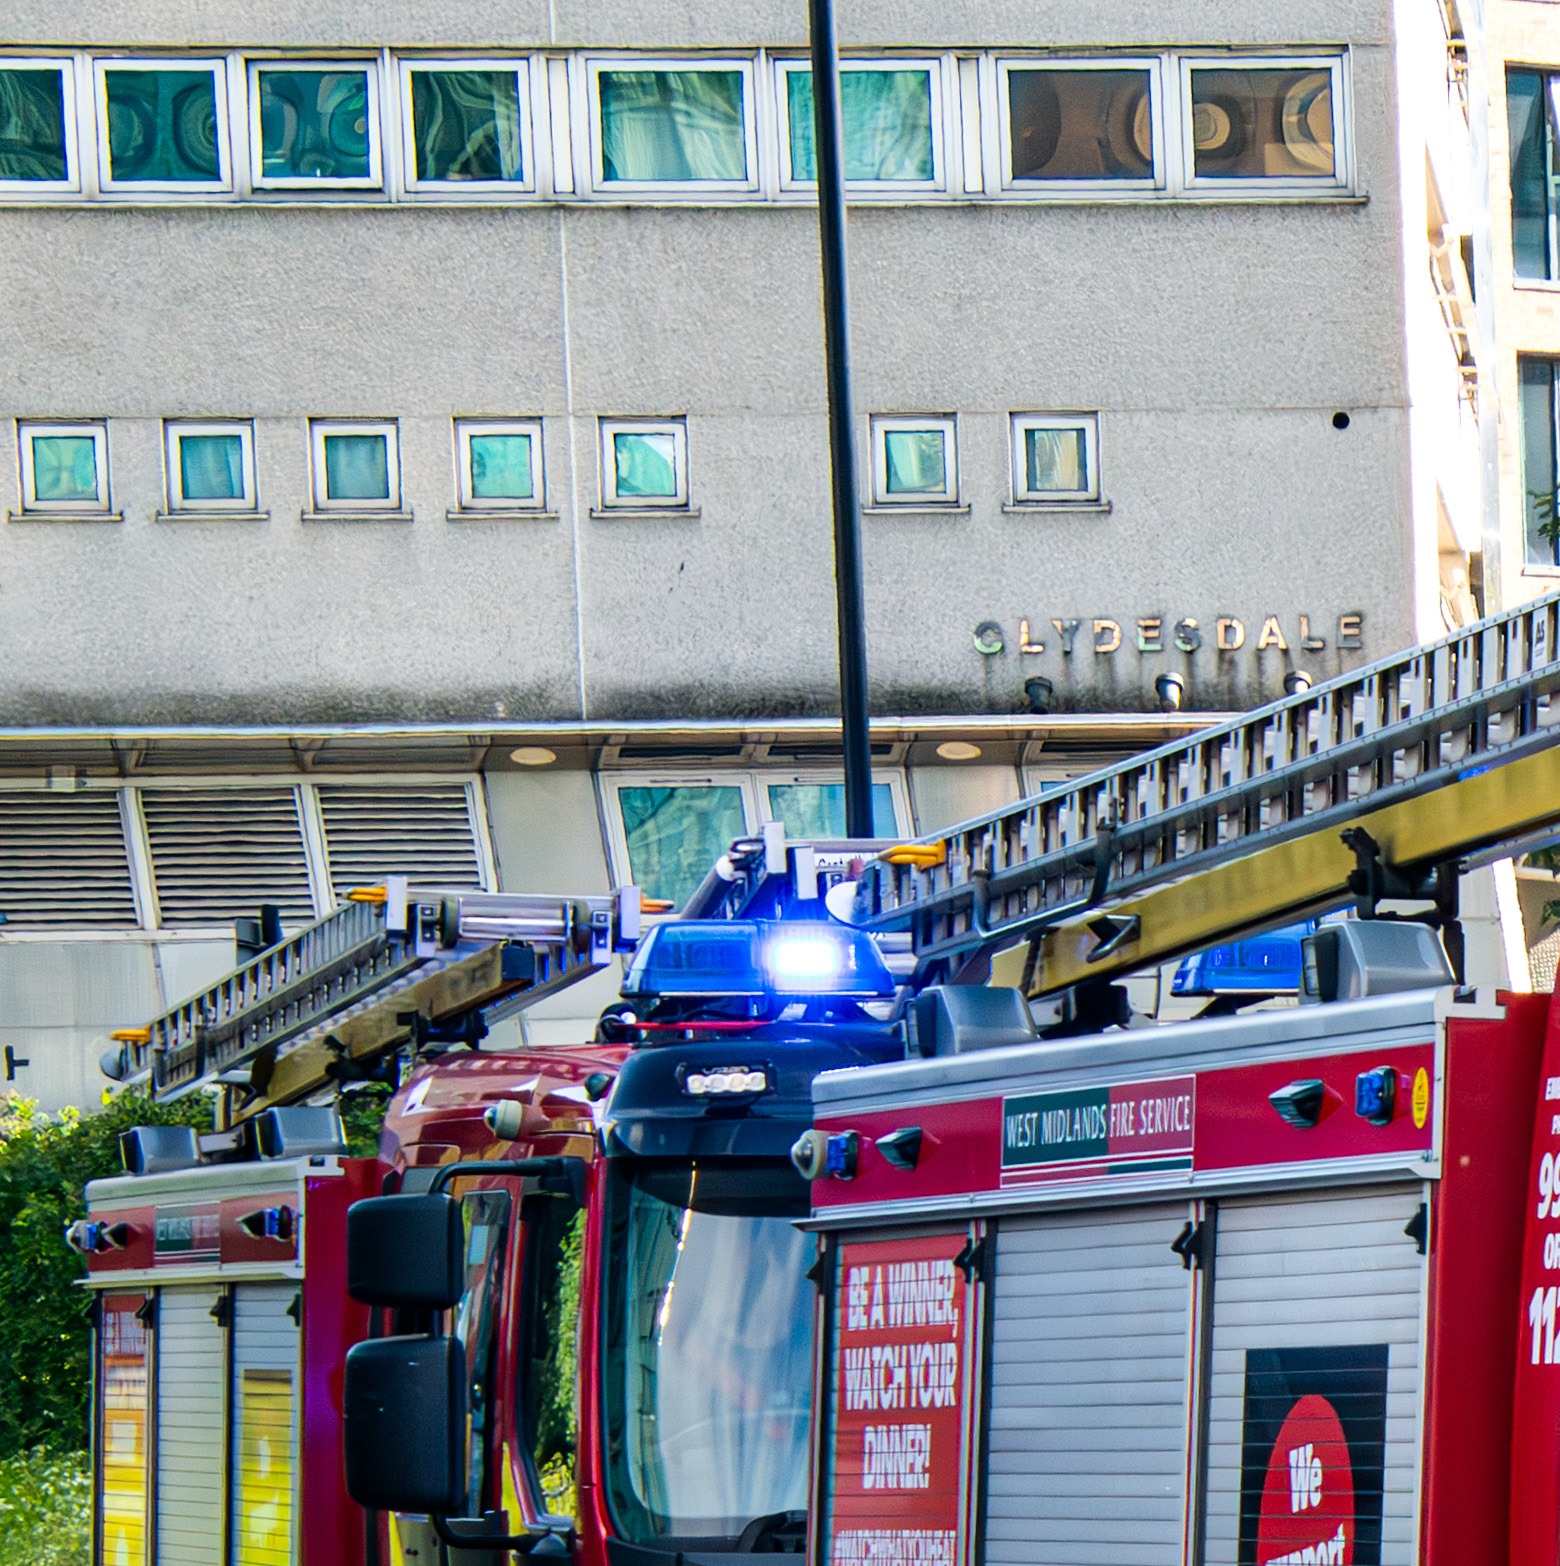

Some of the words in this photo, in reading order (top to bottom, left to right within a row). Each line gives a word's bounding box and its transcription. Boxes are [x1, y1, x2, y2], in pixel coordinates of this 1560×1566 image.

[973, 611, 1363, 654] CLYDESDALE
[1007, 1112, 1038, 1149] WEST
[1041, 1104, 1107, 1145] MIDLANDS
[1110, 1101, 1136, 1138] FIRE
[1138, 1095, 1190, 1136] SERVICE
[848, 1266, 869, 1331] BE
[870, 1265, 883, 1329] A
[888, 1260, 958, 1337] WINNER,
[845, 1344, 906, 1410] WATCH
[907, 1342, 957, 1408] YOUR
[862, 1423, 931, 1490] DINNER!
[1288, 1443, 1323, 1514] We
